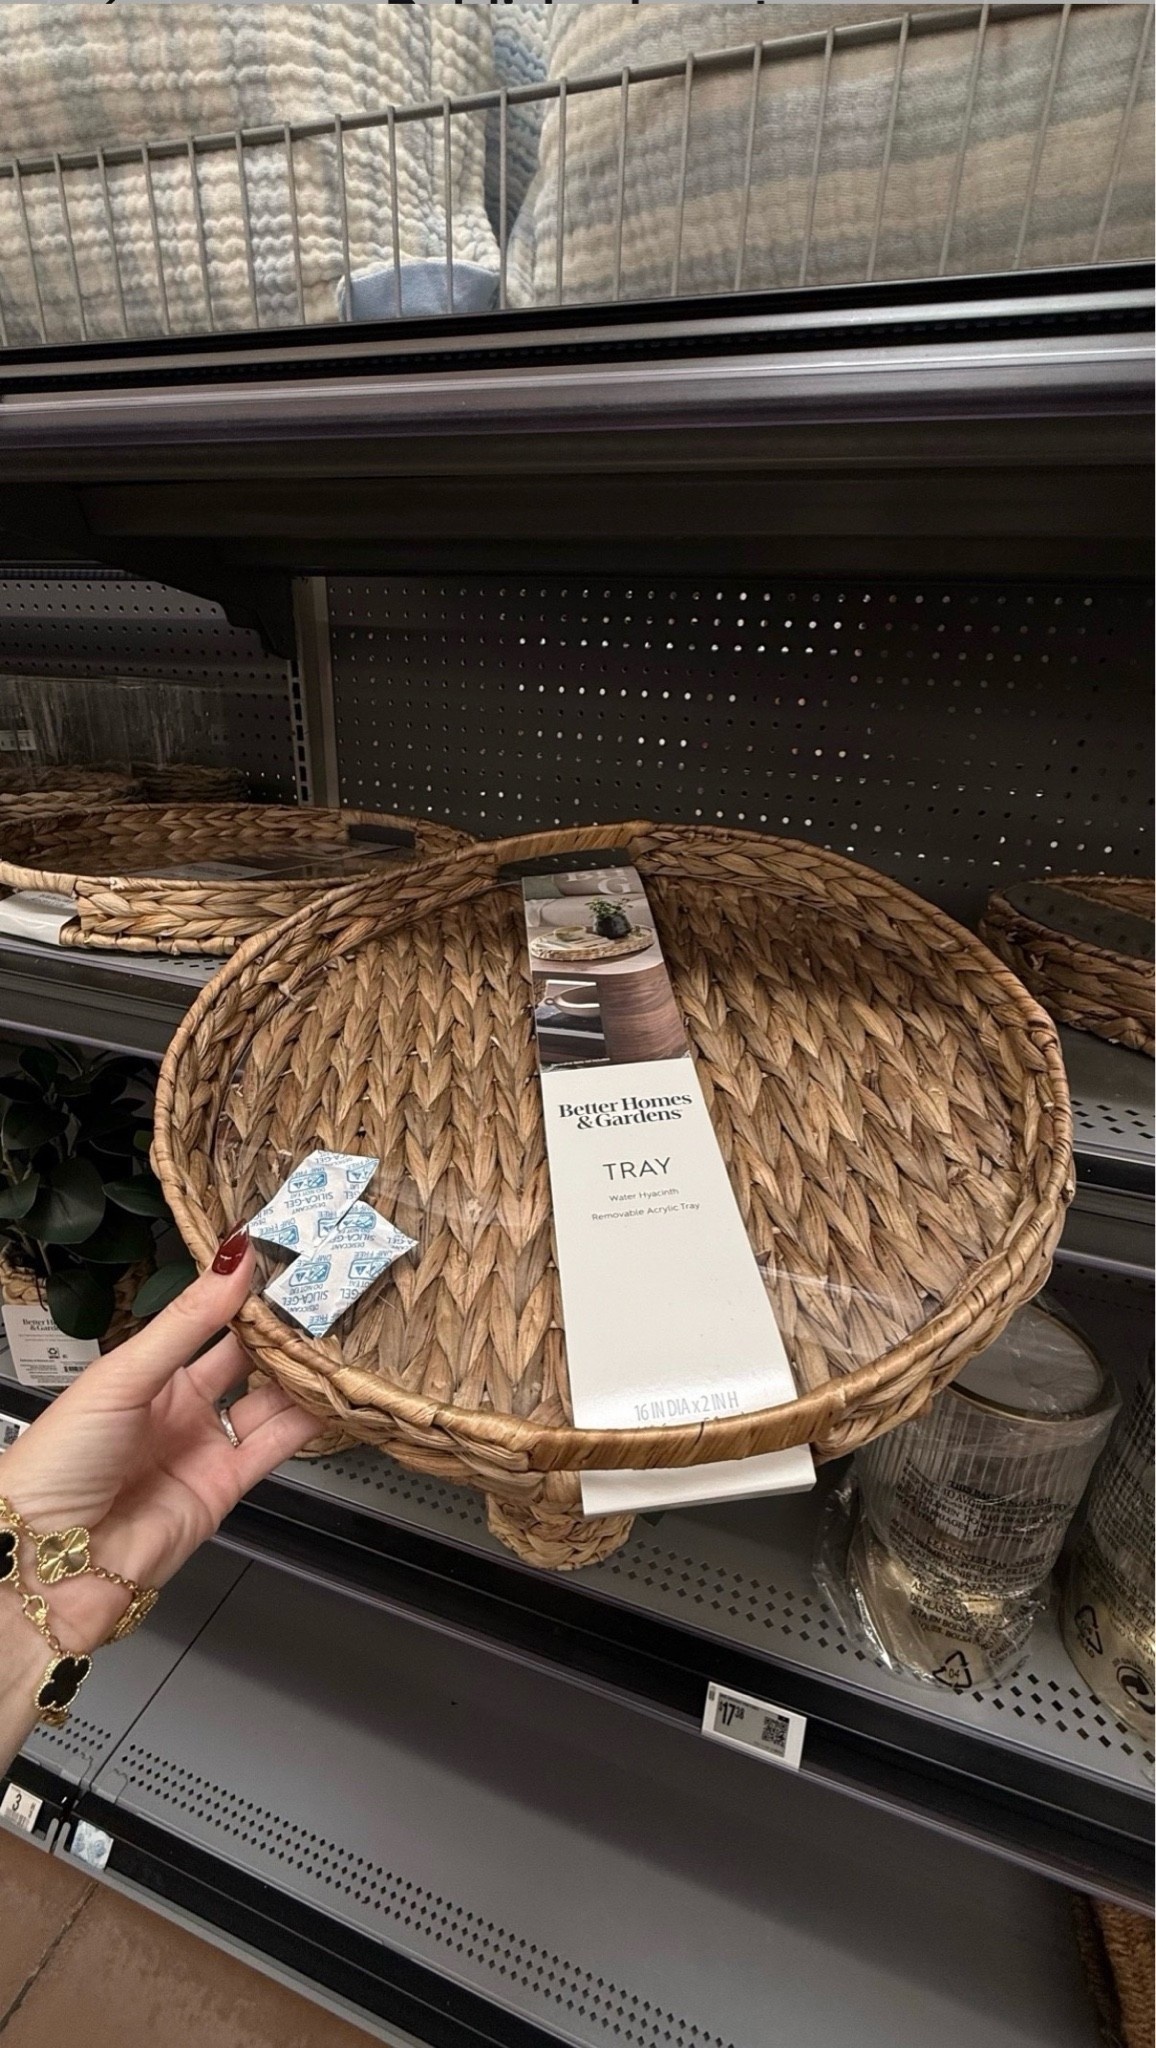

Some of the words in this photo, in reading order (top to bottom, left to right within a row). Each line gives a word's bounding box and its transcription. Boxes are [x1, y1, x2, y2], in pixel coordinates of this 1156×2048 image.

[597, 877, 631, 895] G
[558, 1099, 619, 1118] Better
[622, 1093, 693, 1112] Homes
[594, 1107, 683, 1128] Gardens
[602, 1157, 671, 1181] TRAY
[284, 1191, 334, 1209] SILICA-GEL
[609, 1192, 637, 1203] Water
[639, 1187, 680, 1201] Hyacinth
[591, 1208, 645, 1221] Removable
[646, 1203, 680, 1217] Acrylic
[680, 1201, 701, 1212] Tray
[282, 1290, 329, 1306] SILICA-GEL
[634, 1404, 650, 1421] 16
[651, 1401, 665, 1419] IN
[667, 1397, 692, 1417] DIA
[692, 1401, 701, 1414] x
[702, 1395, 711, 1412] 2
[711, 1393, 727, 1411] IN
[728, 1391, 740, 1408] H
[12, 1793, 22, 1812] 3
